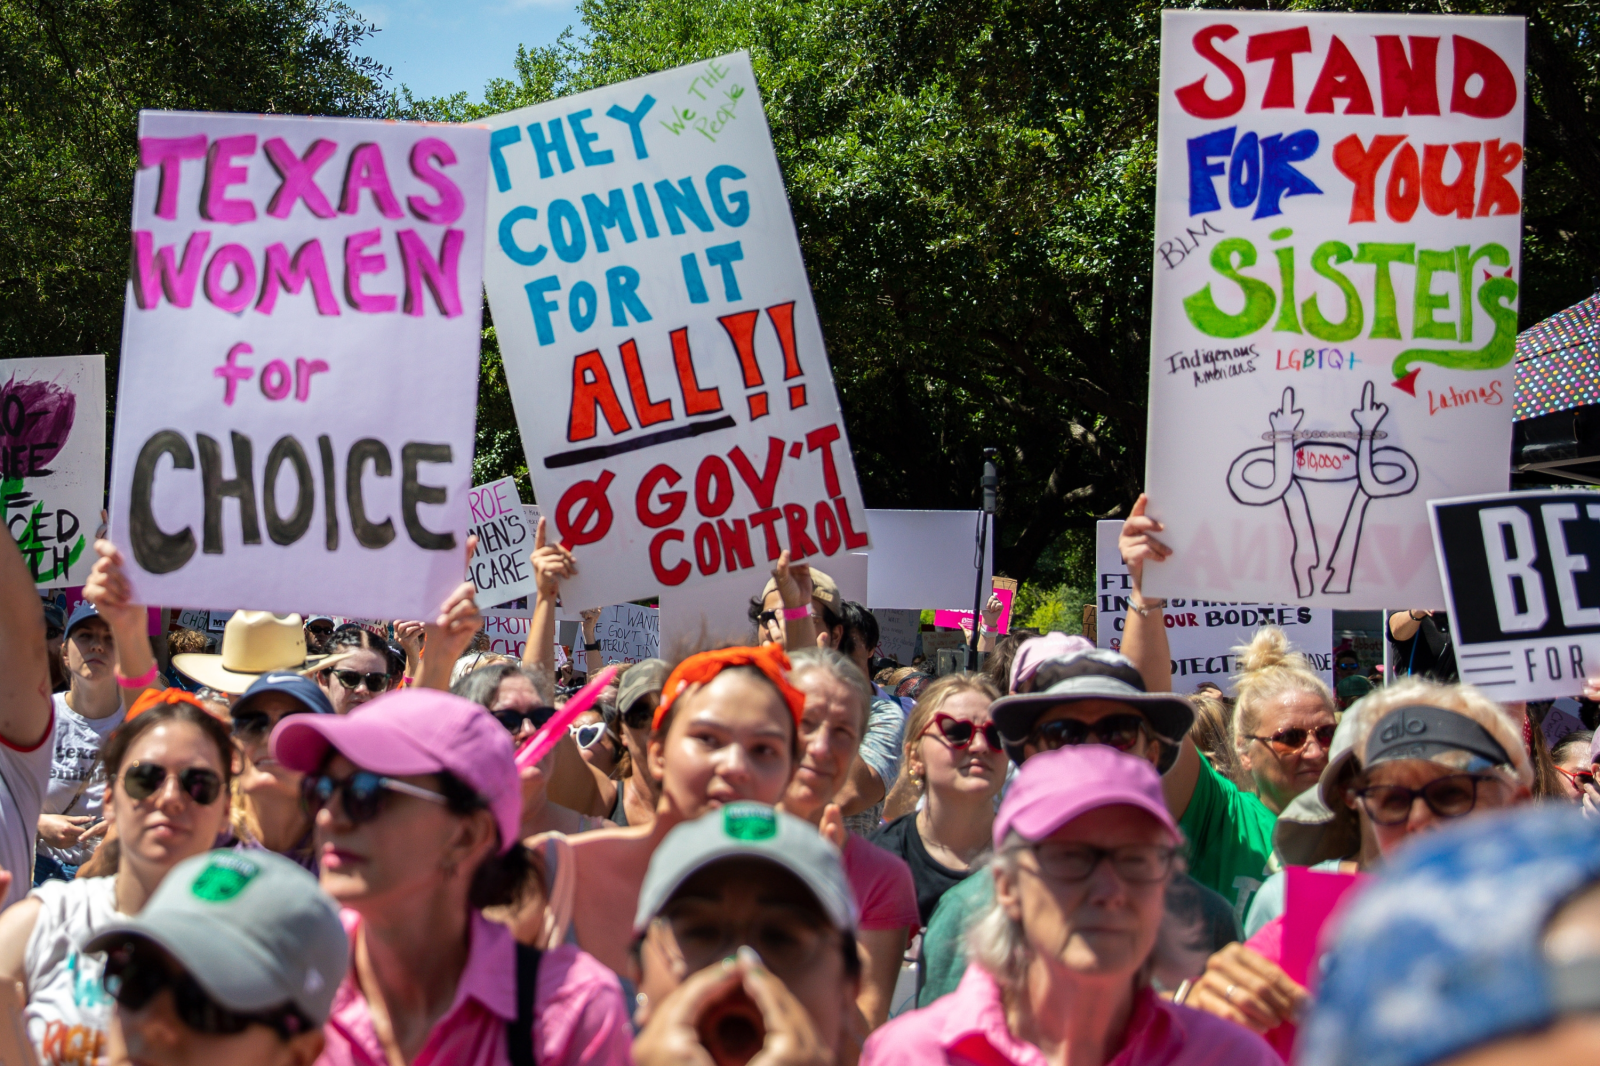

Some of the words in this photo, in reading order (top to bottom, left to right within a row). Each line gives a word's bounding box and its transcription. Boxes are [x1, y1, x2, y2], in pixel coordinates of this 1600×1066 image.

[659, 105, 697, 136] We
[688, 58, 731, 101] THE
[1174, 23, 1517, 119] STAND
[490, 94, 657, 193] THEY
[692, 83, 745, 143] People
[139, 133, 466, 225] TEXAS
[1186, 125, 1324, 221] FOR
[1332, 132, 1523, 225] YOUR
[498, 165, 750, 266] COMING
[1158, 218, 1224, 270] BLM
[131, 227, 465, 318] WOMEN
[524, 265, 653, 346] FOR
[680, 240, 744, 304] IT
[214, 342, 330, 406] for
[567, 300, 808, 443] ALL!!
[1164, 343, 1260, 374] Indigenous
[1193, 360, 1256, 388] Americans
[1276, 348, 1363, 372] LGBTQ+
[0, 442, 59, 483] IFE
[635, 423, 842, 528] GOV'T
[129, 429, 457, 575] CHOICE
[467, 515, 526, 557] MEN'S
[465, 549, 529, 593] HCARE
[648, 496, 869, 587] CONTROL
[1478, 502, 1600, 634] BE
[1205, 606, 1312, 627] BODIES
[1524, 644, 1586, 683] FOR
[1380, 711, 1427, 743] alo
